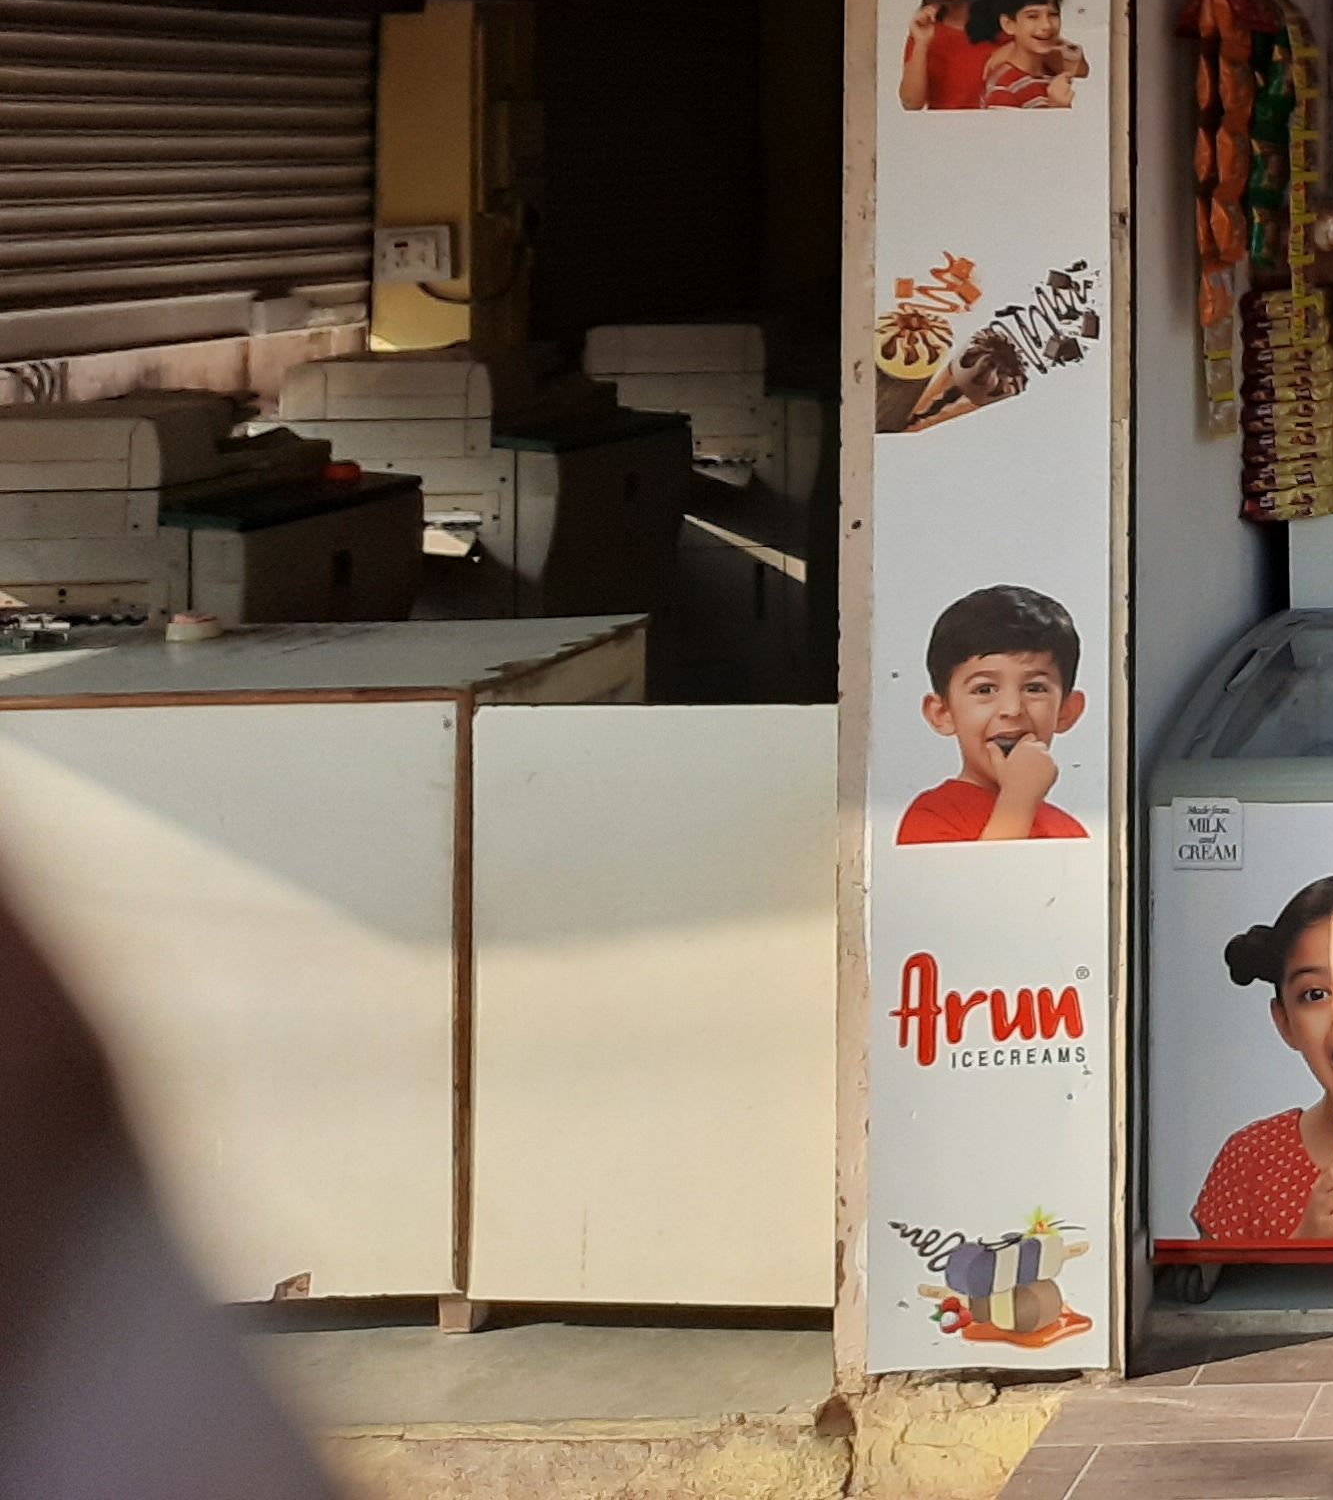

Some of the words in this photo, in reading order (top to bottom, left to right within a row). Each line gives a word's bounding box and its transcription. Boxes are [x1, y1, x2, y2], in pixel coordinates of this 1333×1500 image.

[1188, 817, 1227, 833] MILK
[1178, 844, 1237, 861] CREAM
[888, 951, 1085, 1067] Arun
[951, 1045, 1087, 1070] ICECREAMS
